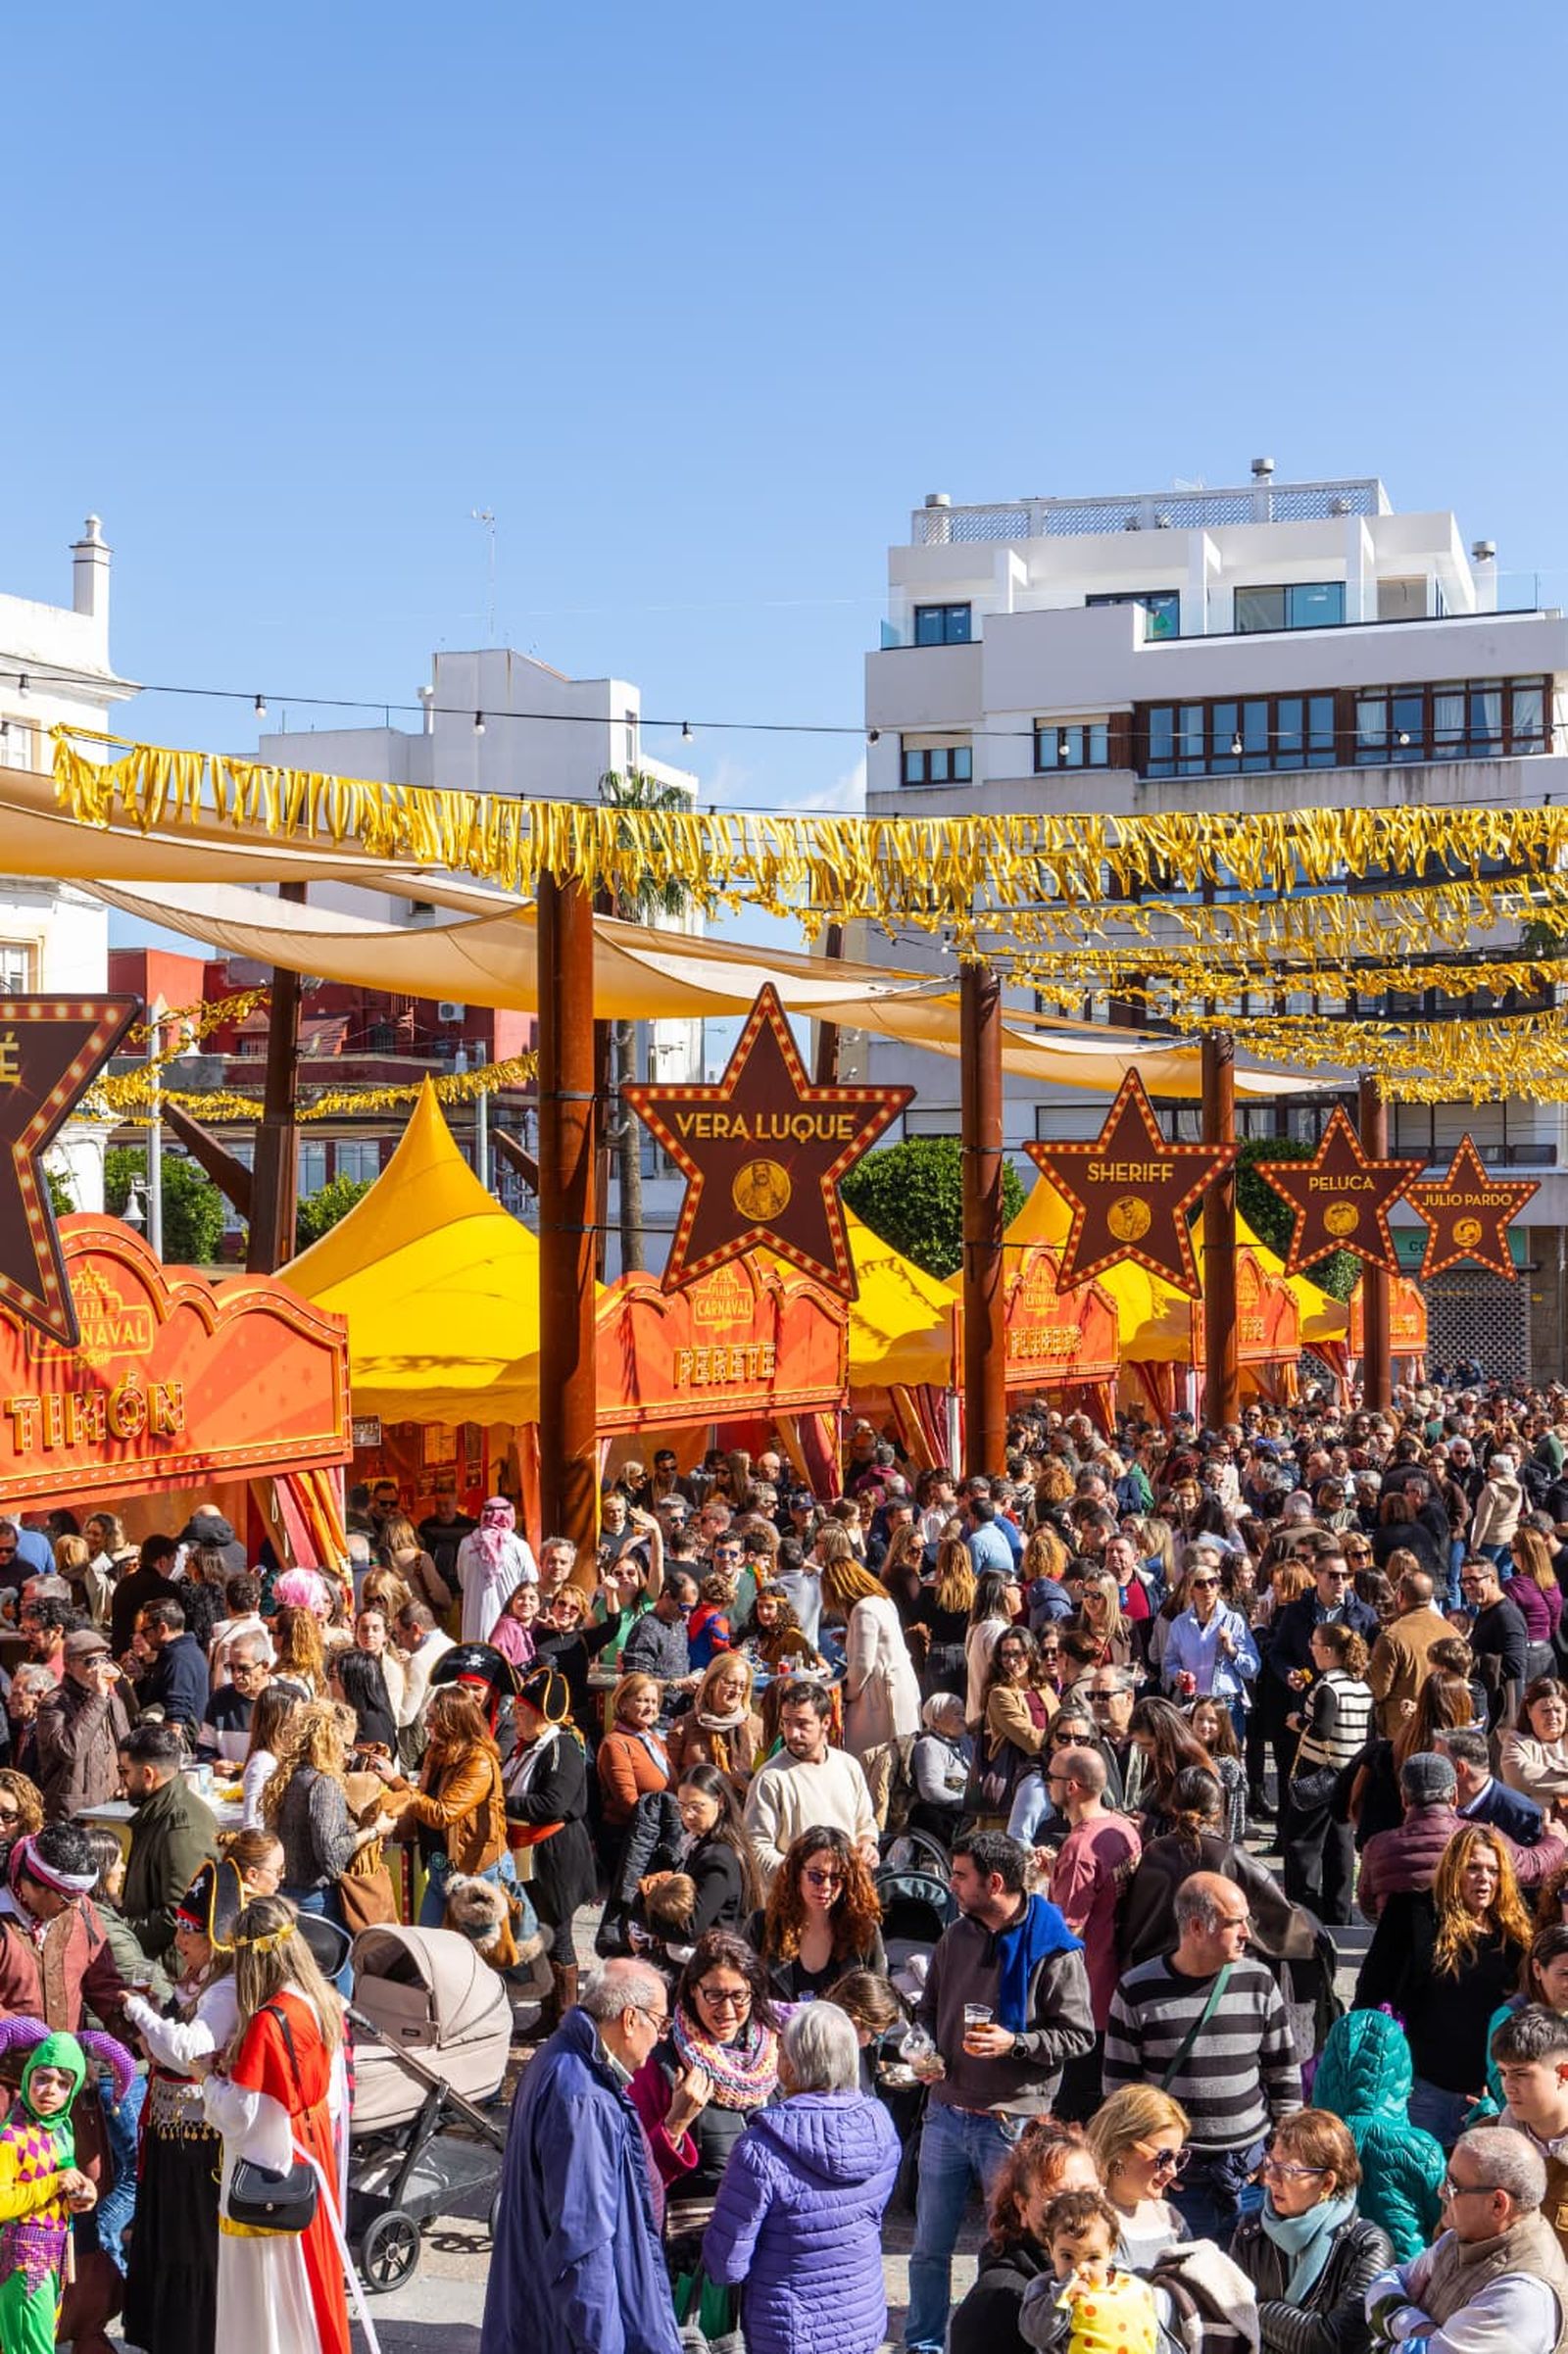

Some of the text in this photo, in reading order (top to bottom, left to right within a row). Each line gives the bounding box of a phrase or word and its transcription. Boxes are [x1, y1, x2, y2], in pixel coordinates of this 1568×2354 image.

[675, 1112, 856, 1144] VERA LUQUE
[1087, 1162, 1175, 1183] SHERIFF
[1308, 1175, 1376, 1192] PELUCA
[1422, 1194, 1513, 1206] JULIO PARDO
[697, 1298, 751, 1318] CARNAVAL
[674, 1342, 776, 1385] PERETE
[4, 1371, 184, 1452] TIMÓN
